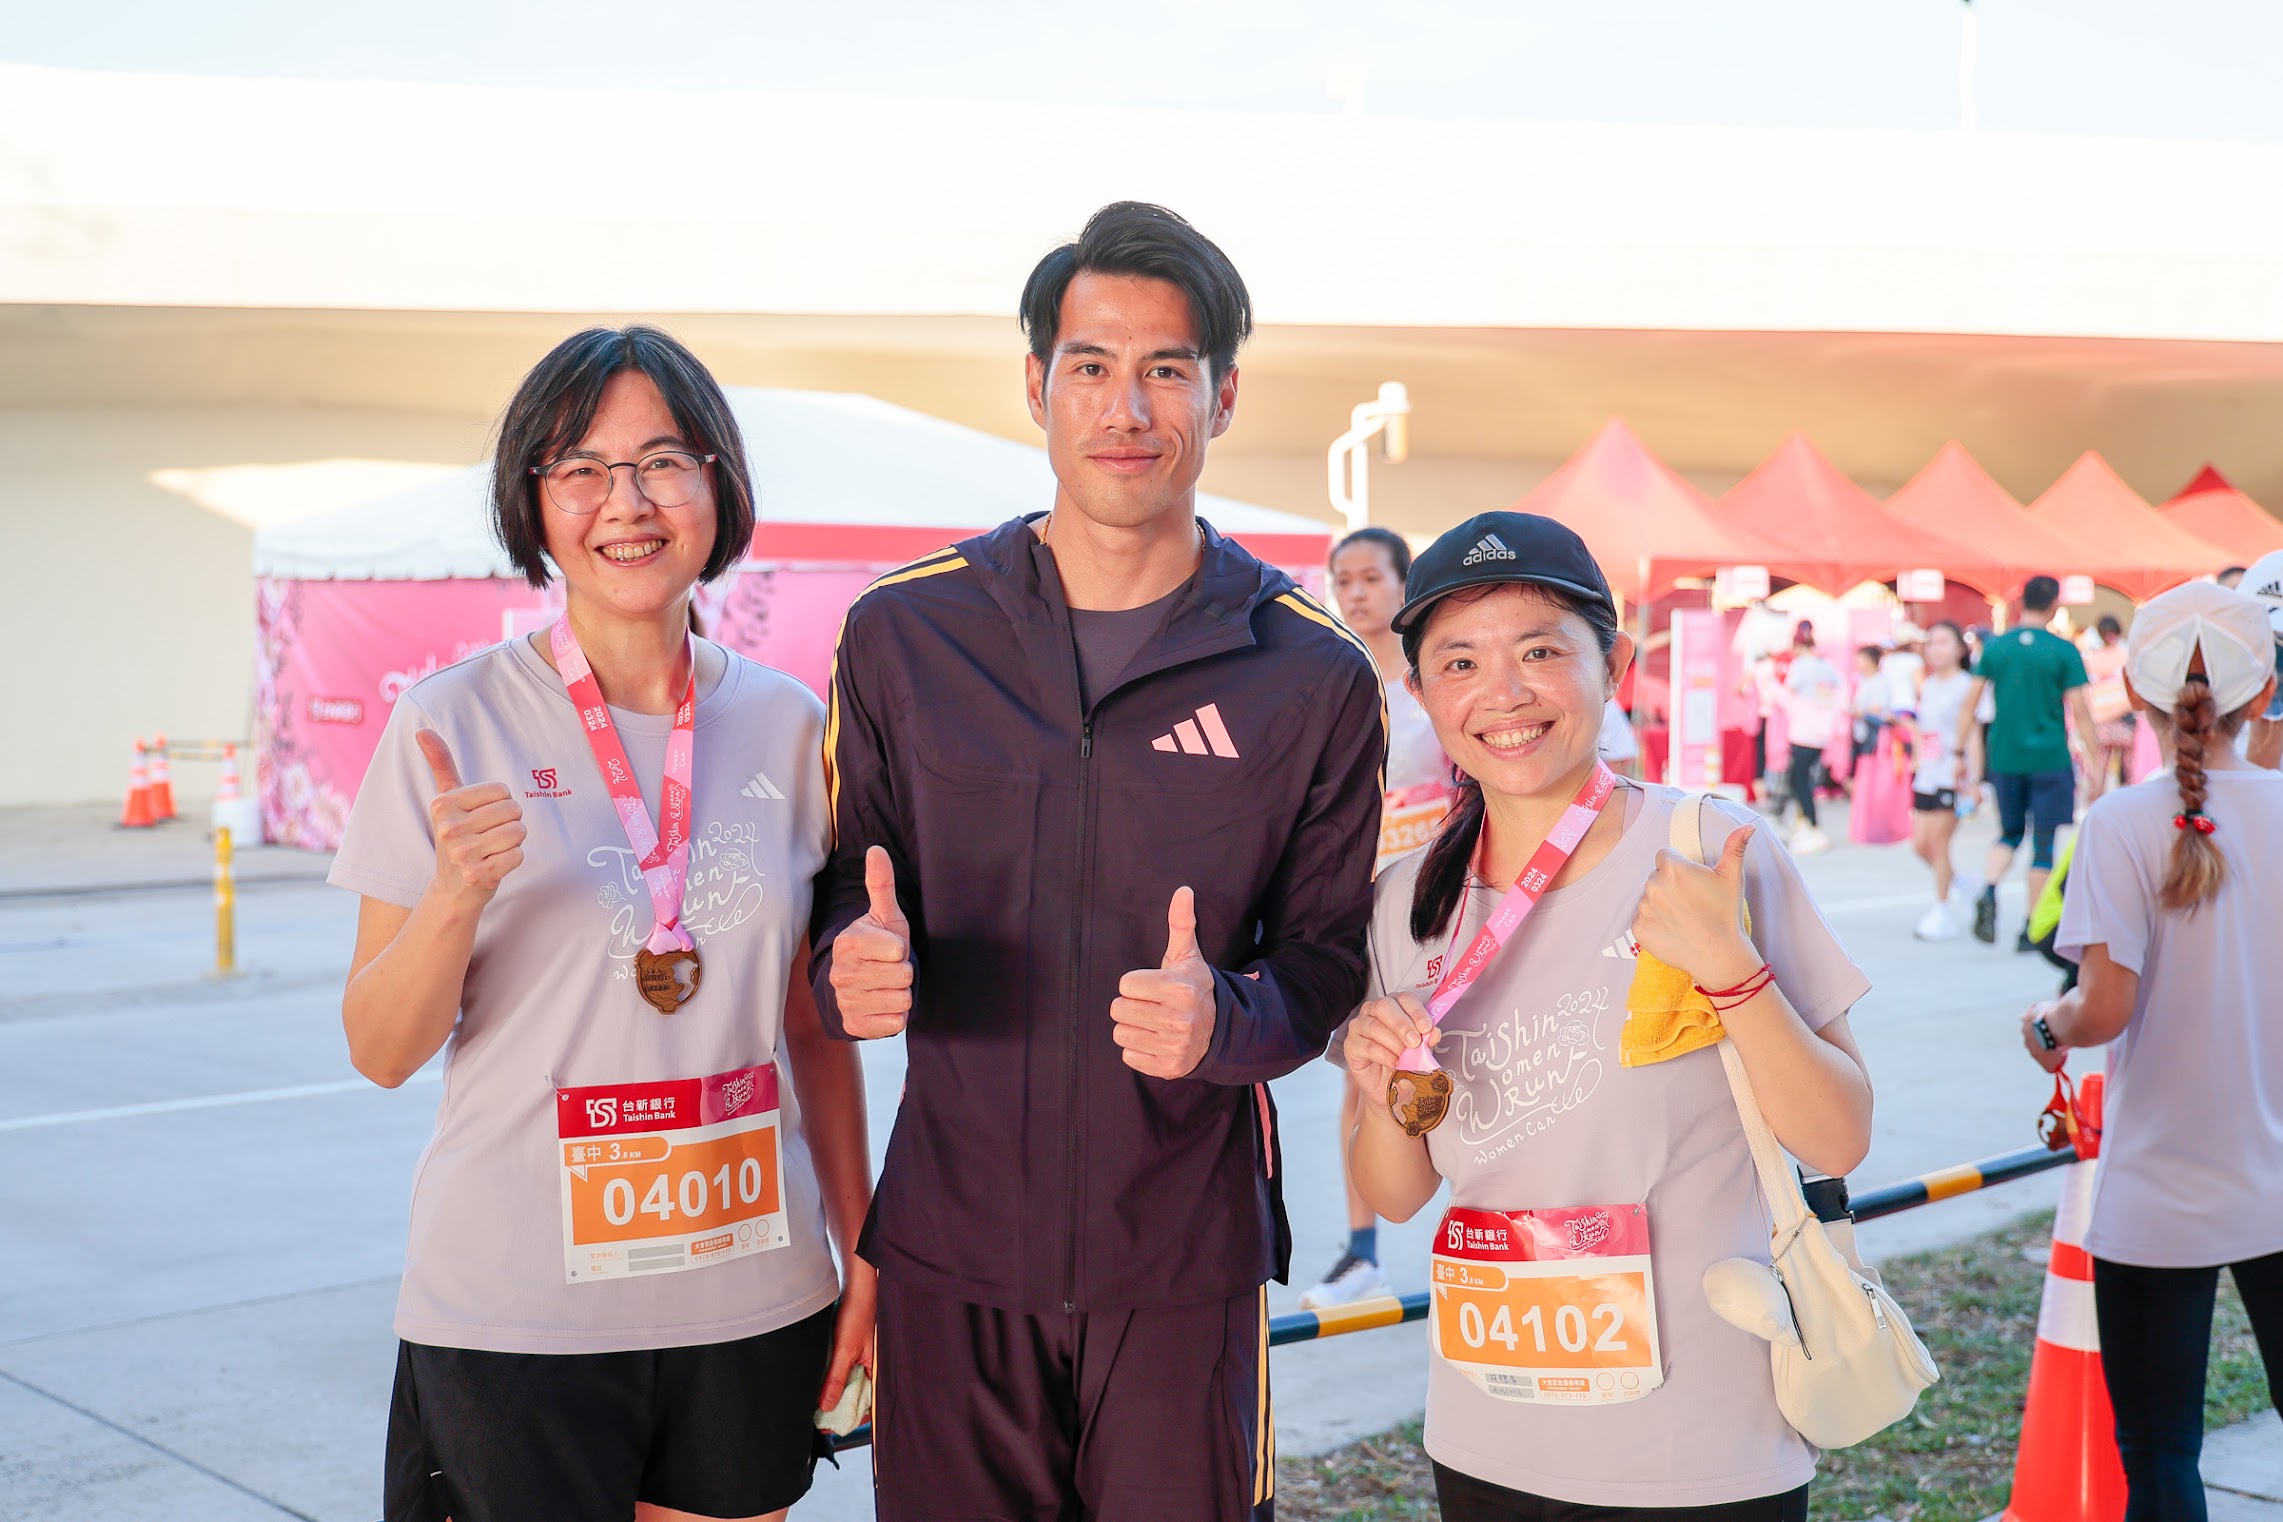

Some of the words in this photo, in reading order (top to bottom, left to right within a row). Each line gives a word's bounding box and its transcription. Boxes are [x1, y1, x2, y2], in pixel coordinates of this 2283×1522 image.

[1463, 549, 1516, 566] adidas
[584, 710, 598, 731] 0324
[594, 706, 608, 729] 2024
[608, 759, 628, 784] 2024
[553, 789, 573, 797] Bank
[708, 821, 762, 860] 2024
[1521, 867, 1538, 888] 2024
[1530, 874, 1548, 892] 0324
[1557, 986, 1609, 1034] 2024
[1503, 1055, 1573, 1116] Run
[622, 1097, 676, 1112] 台新銀行
[623, 1113, 653, 1122] Taishin
[654, 1110, 676, 1120] Bank
[1474, 1132, 1525, 1165] Women
[1525, 1115, 1556, 1136] Can
[571, 1145, 601, 1162] 臺中
[609, 1142, 628, 1160] 3.8
[603, 1158, 762, 1226] 04010
[1466, 1227, 1508, 1241] 台新銀行
[1467, 1241, 1489, 1250] Taishin
[1459, 1301, 1628, 1353] 04102
